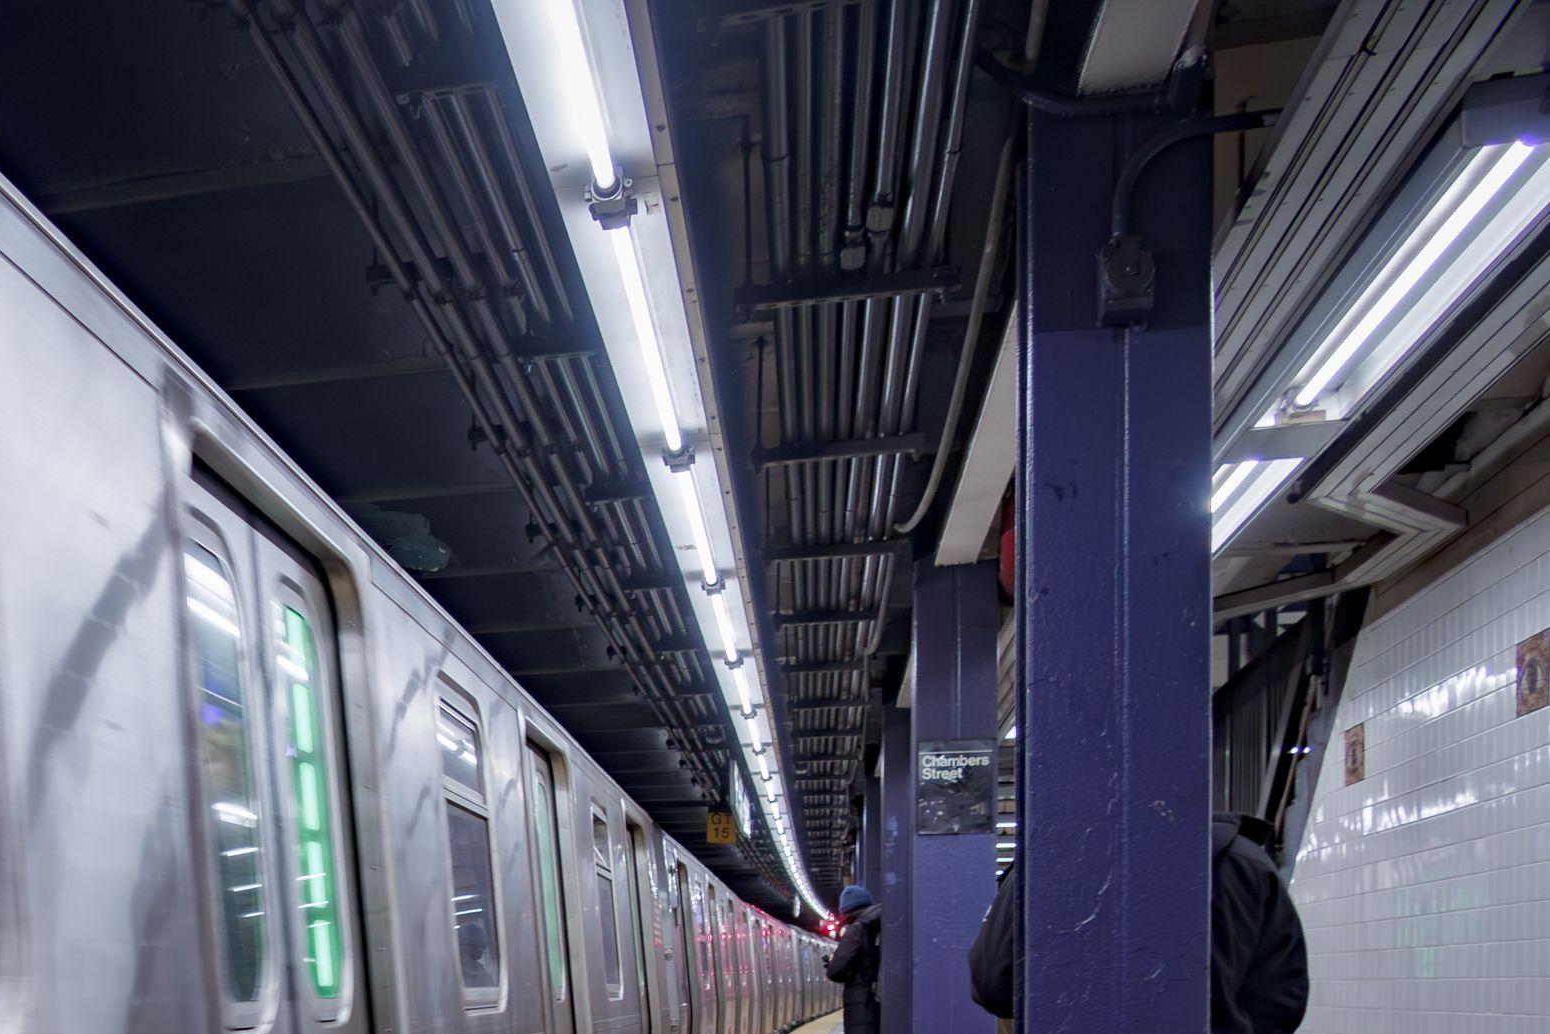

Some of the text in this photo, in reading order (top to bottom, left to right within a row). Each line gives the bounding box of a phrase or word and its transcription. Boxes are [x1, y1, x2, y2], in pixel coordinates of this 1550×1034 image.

[922, 754, 990, 768] Chambers
[921, 767, 963, 781] Street
[713, 827, 730, 839] 15
